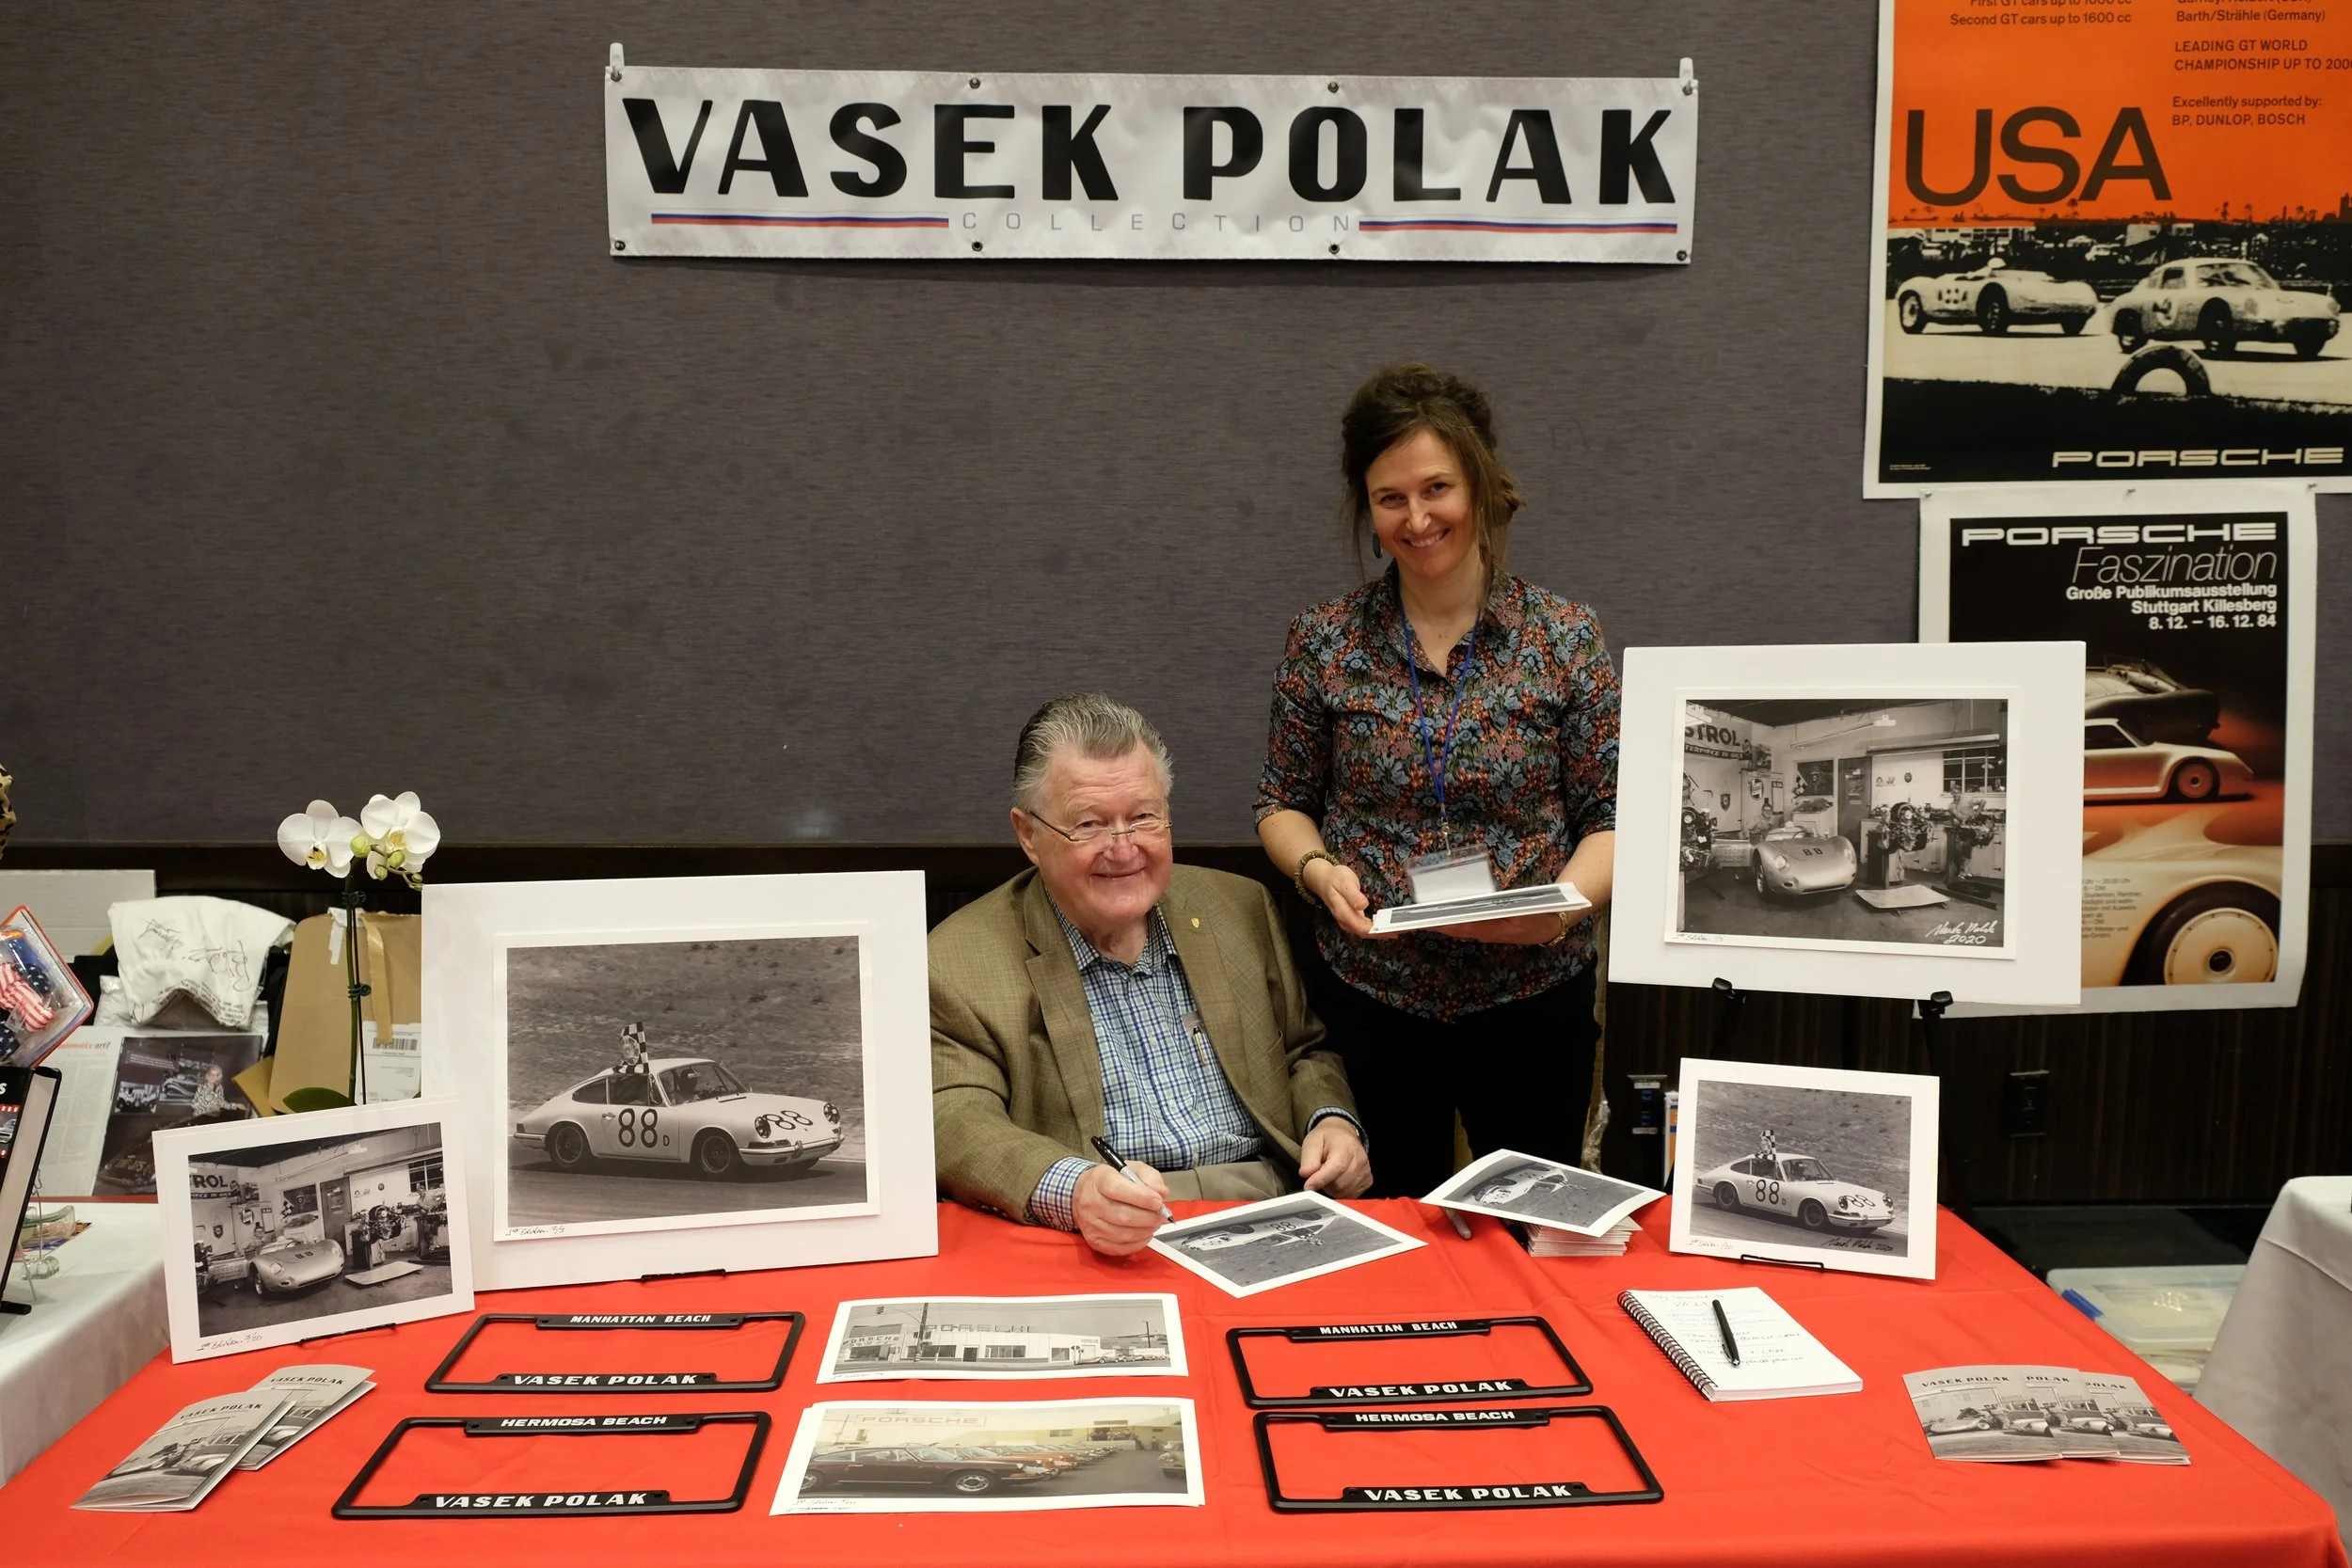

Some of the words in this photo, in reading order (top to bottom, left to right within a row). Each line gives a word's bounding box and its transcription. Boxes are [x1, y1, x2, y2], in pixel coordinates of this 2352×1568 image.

[1950, 13, 1996, 25] Second
[2000, 13, 2018, 24] GT
[2021, 15, 2047, 24] cars
[2050, 15, 2065, 26] up
[2068, 12, 2080, 24] to
[2084, 12, 2113, 24] 1600
[2117, 13, 2132, 23] cc
[2176, 9, 2261, 22] Barth/Strähle
[2264, 9, 2326, 23] (Germany)
[2175, 40, 2234, 53] LEADING
[2238, 40, 2257, 52] GT
[2260, 40, 2308, 51] WORLD
[2174, 58, 2280, 71] CHAMPIONSHIP
[2283, 58, 2301, 70] UP
[2304, 58, 2322, 70] TO
[2172, 95, 2239, 109] Excellently
[2241, 95, 2302, 109] supported
[2304, 96, 2322, 110] by:
[2257, 113, 2306, 125] BOSCH
[622, 98, 1119, 200] VASEK
[1183, 106, 1676, 204] POLAK
[1905, 106, 2172, 207] USA
[963, 212, 1349, 232] COLLECTION
[2052, 448, 2344, 467] PORSCHE
[1962, 522, 2277, 546] PORSCHE
[2072, 544, 2278, 583] Faszination
[2066, 585, 2112, 600] Große
[2116, 583, 2278, 598] Publikumsausstellung
[2131, 600, 2200, 616] Stuttgart
[2203, 598, 2278, 614] Killesberg
[2149, 617, 2164, 630] 8.
[2166, 617, 2187, 629] 12.
[2208, 615, 2230, 628] 16.
[2233, 615, 2254, 628] 12.
[2257, 614, 2277, 627] 84
[1803, 847, 1823, 856] 88
[1943, 935, 1986, 944] 2020
[762, 1110, 814, 1130] 88
[618, 1108, 658, 1148] 88
[663, 1135, 670, 1147] D
[190, 1174, 228, 1188] ROL
[1756, 1180, 1779, 1205] 88
[1844, 1195, 1875, 1207] 88
[664, 1314, 712, 1323] BEACH
[1320, 1324, 1404, 1336] MANHATTAN
[1412, 1322, 1457, 1332] BEACH
[514, 1374, 598, 1386] VASEK
[608, 1373, 697, 1386] POLAK
[1922, 1379, 1963, 1387] VASEK
[1329, 1384, 1417, 1398] VASEK
[1423, 1380, 1513, 1395] POLAK
[501, 1418, 596, 1428] HERMOSA
[602, 1416, 668, 1427] BEACH
[1356, 1413, 1448, 1422] HERMOSA
[1453, 1411, 1515, 1421] BEACH
[1364, 1487, 1465, 1502] VASEK
[1470, 1484, 1573, 1500] POLAK
[435, 1496, 537, 1509] VASEK
[543, 1493, 647, 1507] POLAK
